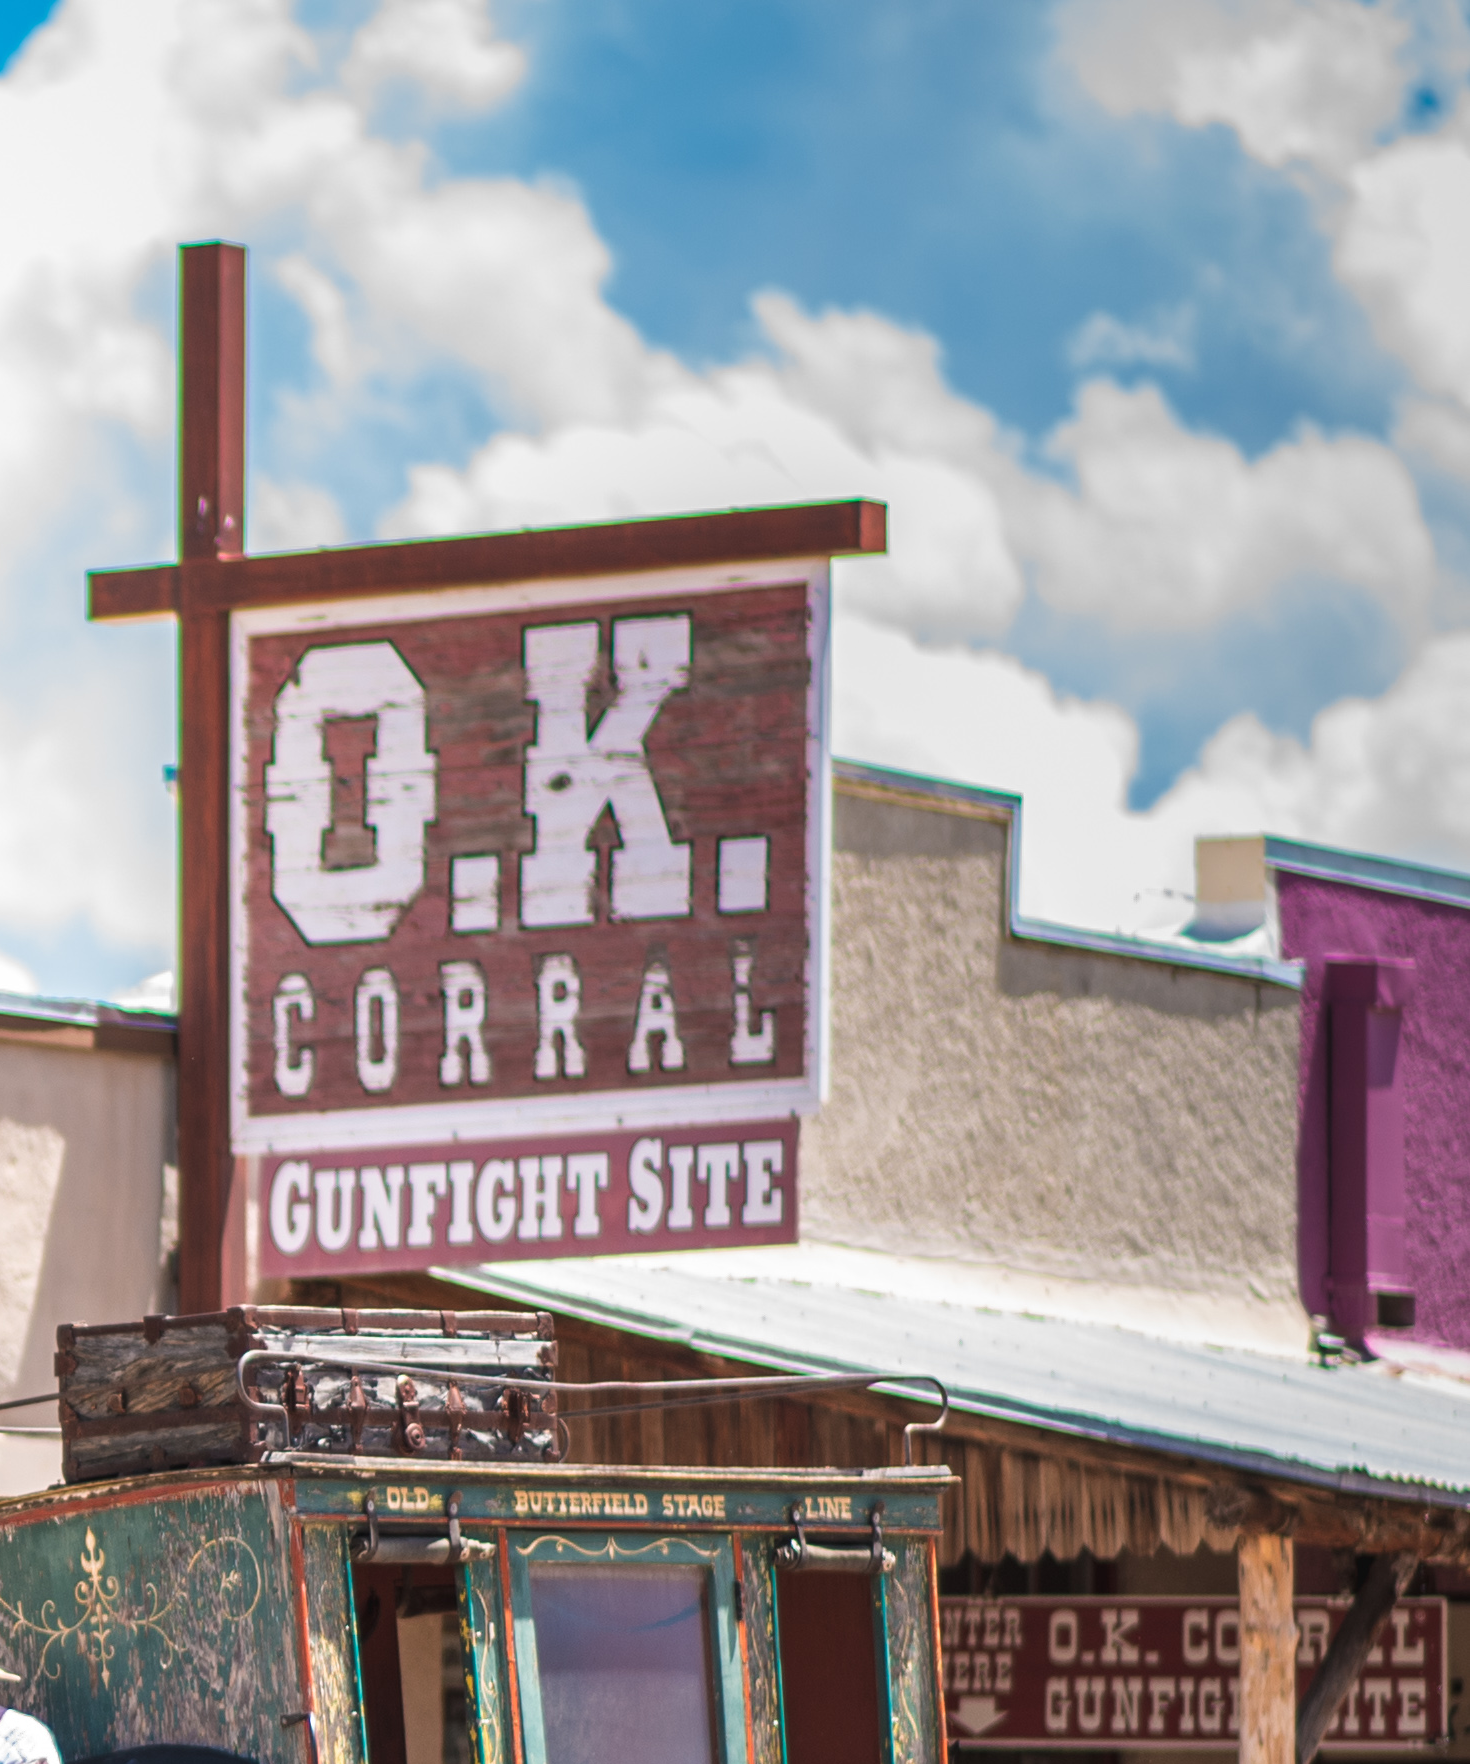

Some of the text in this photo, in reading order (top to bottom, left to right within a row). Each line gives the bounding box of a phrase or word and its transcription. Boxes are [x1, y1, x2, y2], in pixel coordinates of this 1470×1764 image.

[272, 935, 775, 1099] CORRAL
[270, 1136, 784, 1255] GUNFIGHT SITE
[386, 1486, 852, 1520] OLD BUTTERFIELD STAGE LINE
[942, 1607, 1023, 1647] NTER
[1047, 1607, 1160, 1667] O.K.
[1328, 1676, 1427, 1737] ITE
